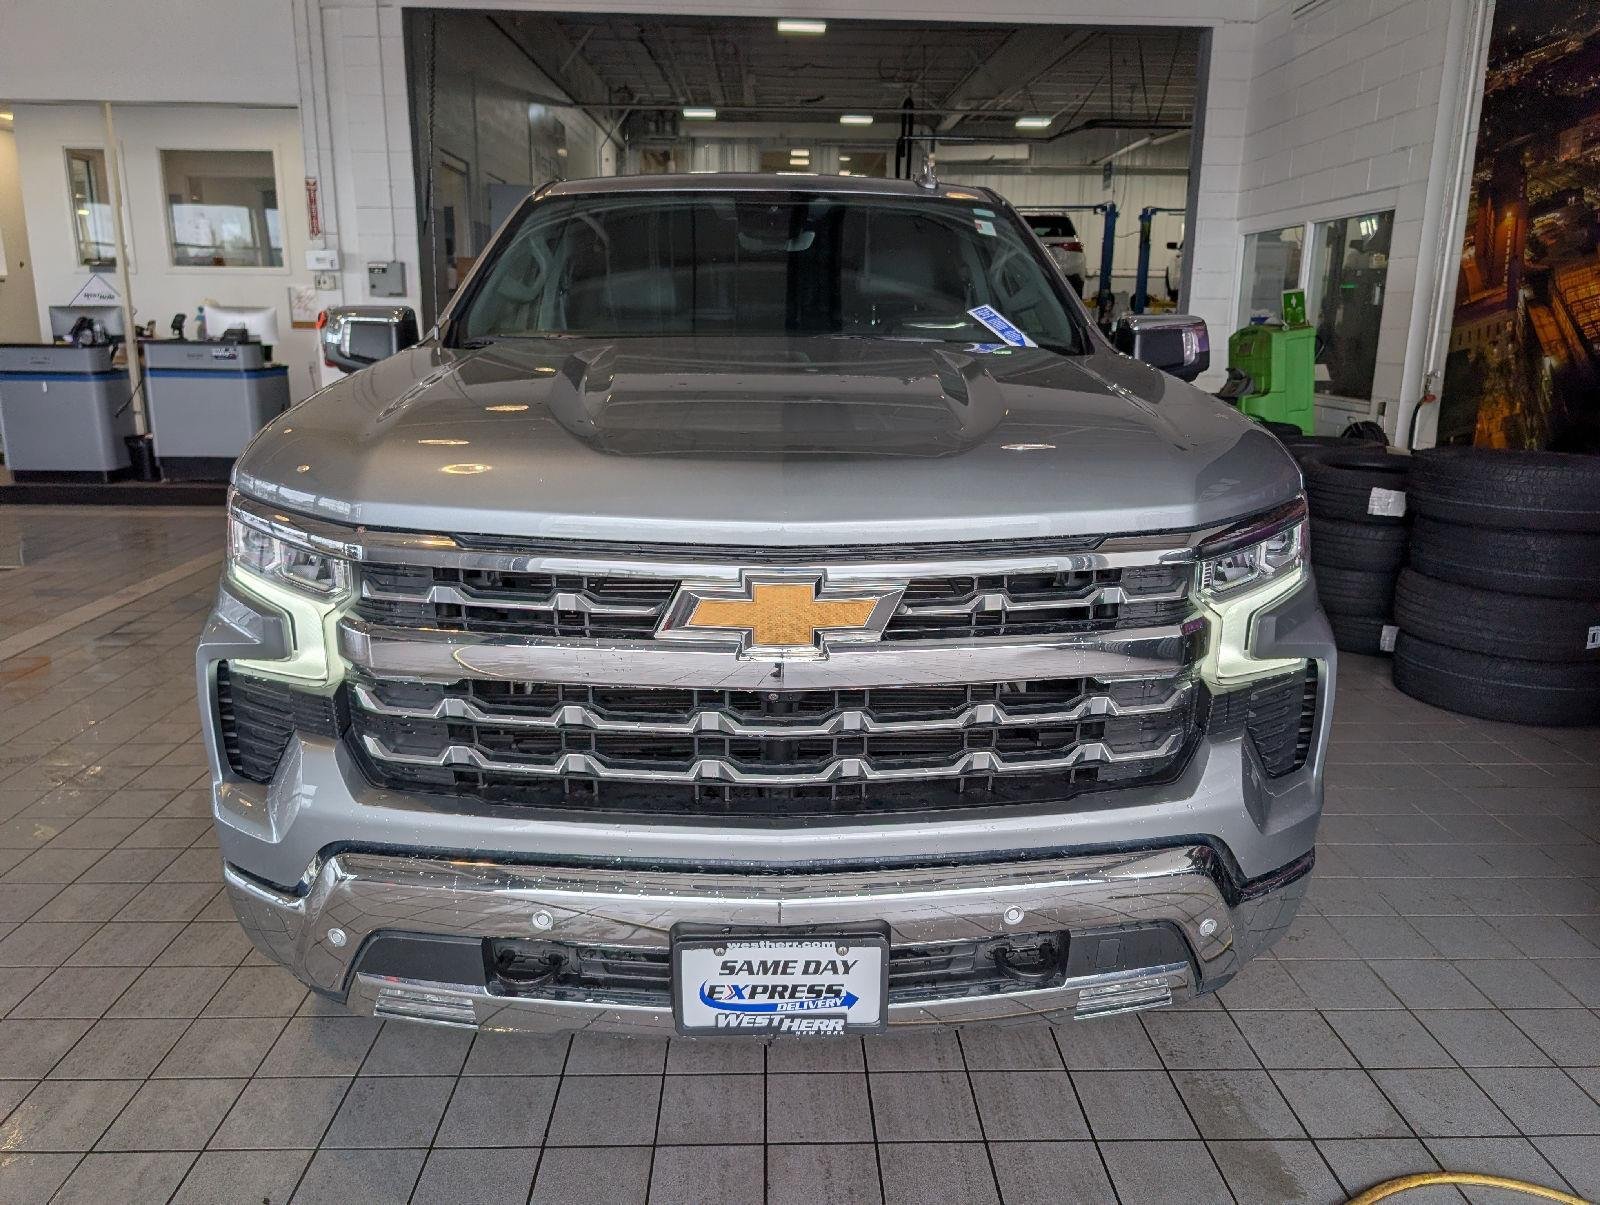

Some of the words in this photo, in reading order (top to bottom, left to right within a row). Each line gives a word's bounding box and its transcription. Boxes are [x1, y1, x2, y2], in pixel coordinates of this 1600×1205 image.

[727, 940, 836, 949] westherr.com
[719, 959, 798, 976] SAME
[801, 959, 859, 976] DAY
[706, 983, 845, 1000] EXPRESS
[776, 997, 844, 1012] DELIVERY
